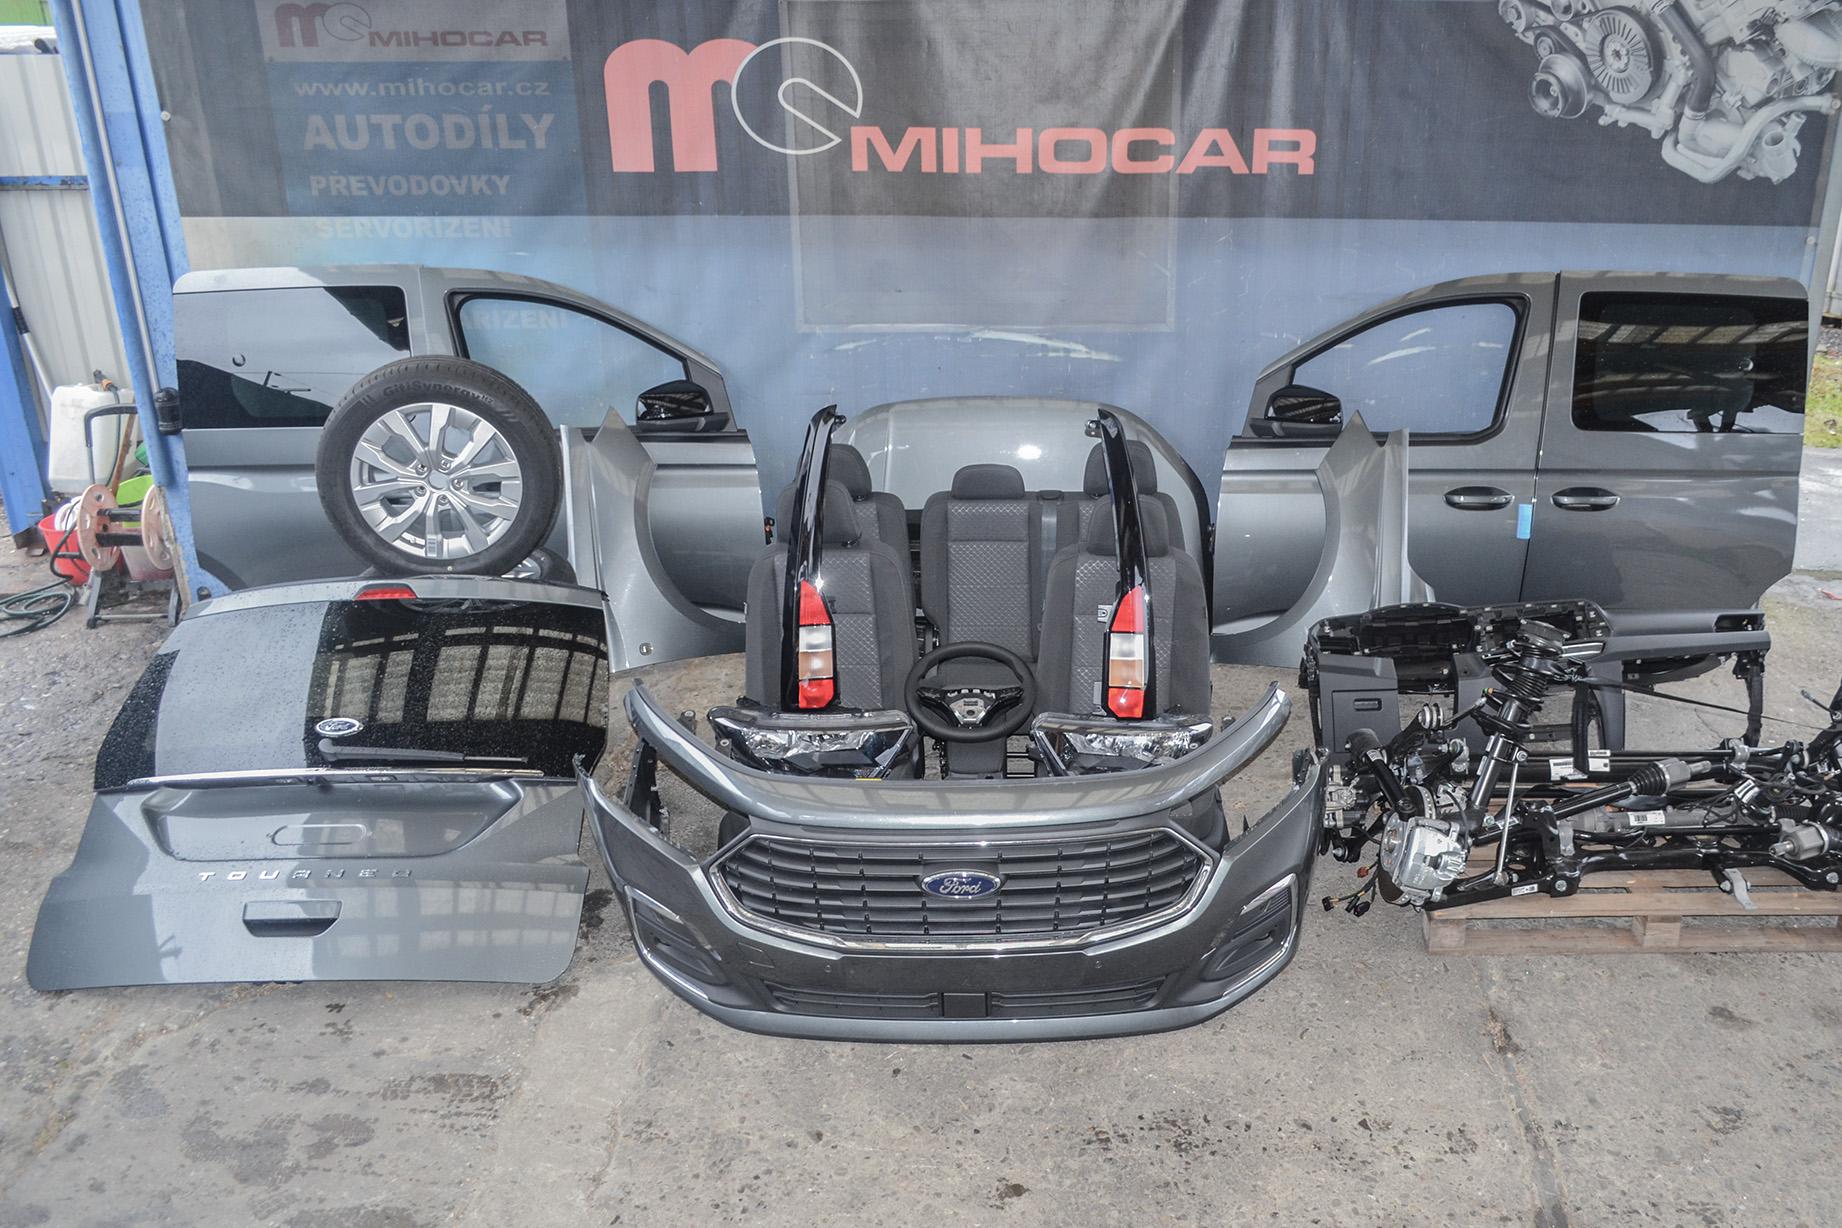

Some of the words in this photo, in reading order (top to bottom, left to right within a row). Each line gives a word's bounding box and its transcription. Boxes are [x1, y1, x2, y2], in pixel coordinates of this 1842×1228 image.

[367, 30, 549, 48] MIHOCAR
[295, 77, 550, 98] www.mihocar.cz
[303, 105, 556, 151] AUTODÍLY
[850, 125, 1317, 176] MIHOCAR
[308, 170, 512, 197] PŘEVODOVKY
[939, 877, 982, 894] Ford
